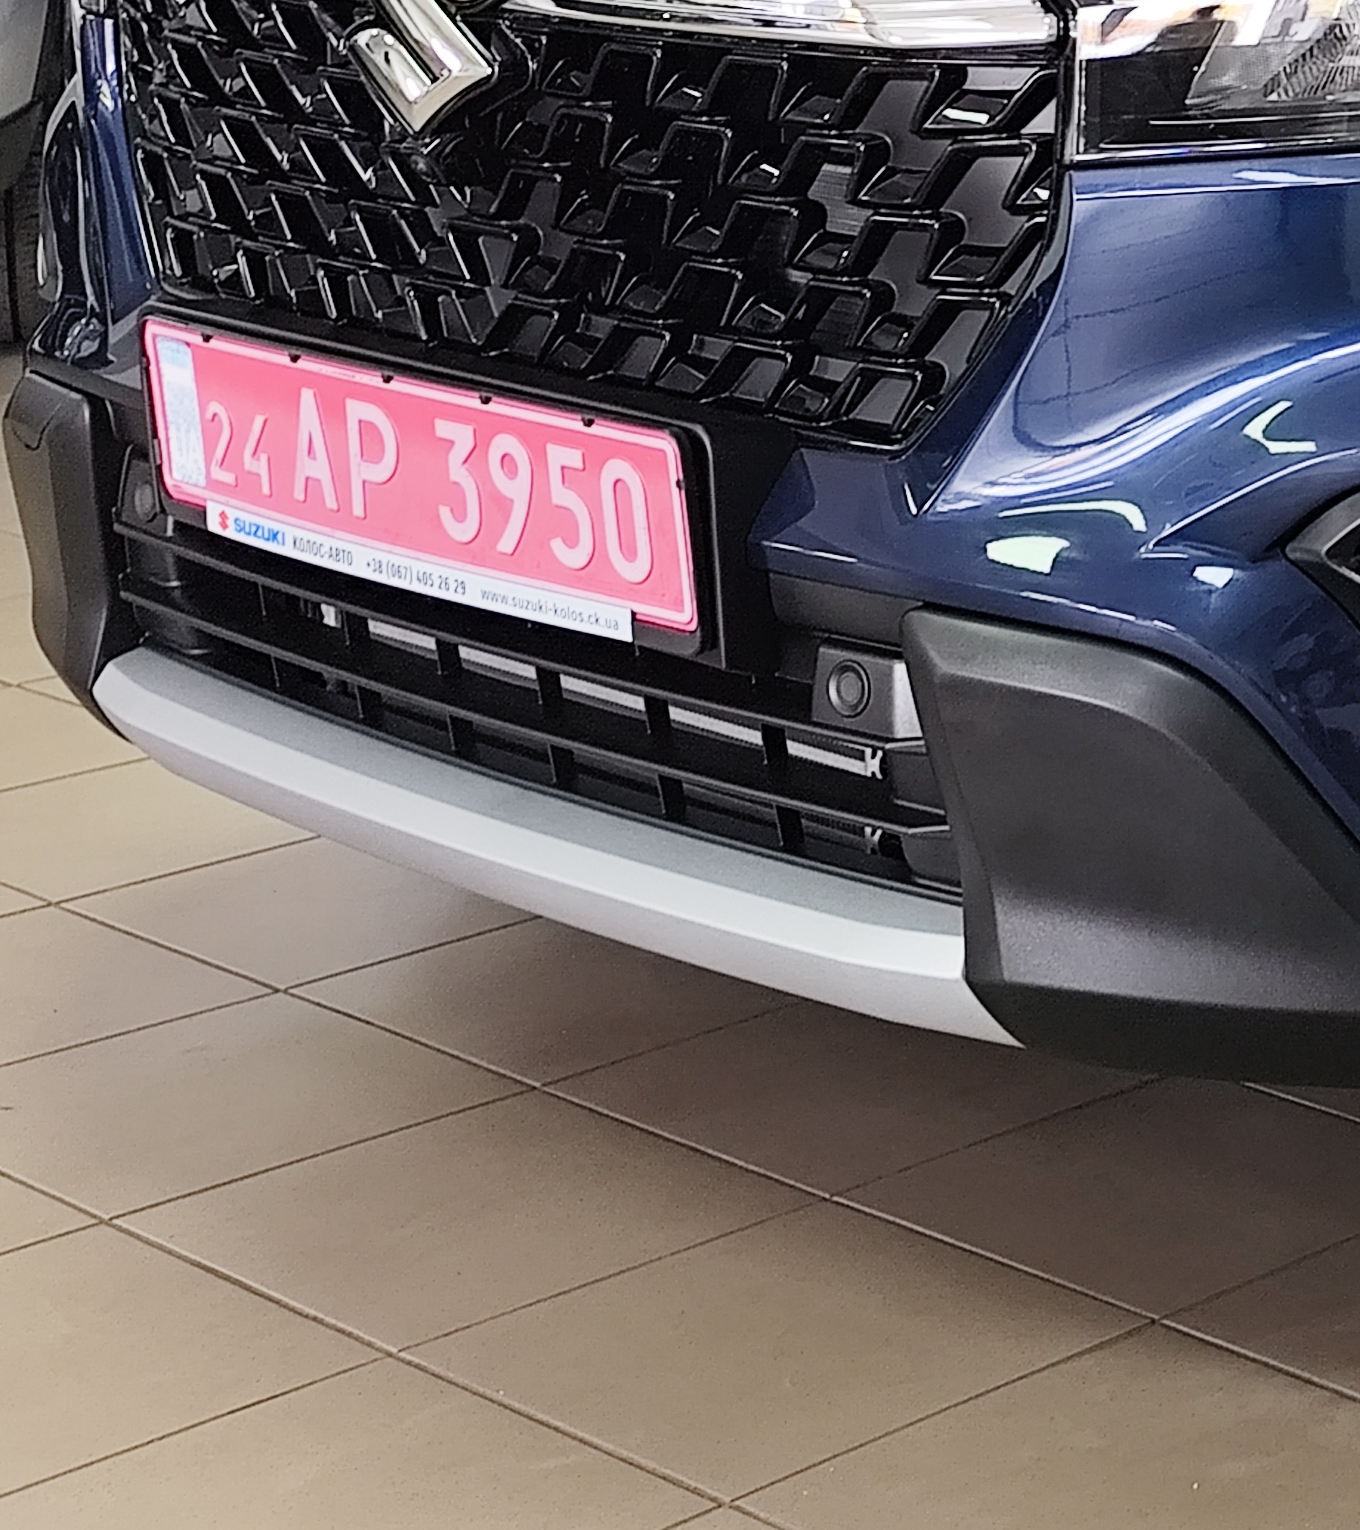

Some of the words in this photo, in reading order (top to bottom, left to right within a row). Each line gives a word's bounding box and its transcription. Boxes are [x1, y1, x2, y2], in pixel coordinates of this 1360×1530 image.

[205, 400, 273, 498] 24
[293, 386, 399, 520] AP
[433, 417, 653, 586] 3950
[233, 517, 286, 547] SUZUKI
[292, 534, 353, 567] КОЛОС-АВТО
[366, 558, 383, 575] +38
[386, 560, 413, 584] (067)
[416, 572, 434, 588] 405
[437, 576, 450, 591] 26
[452, 579, 466, 596] 29
[480, 587, 620, 632] www.suzuki-kolos.ck.ua
